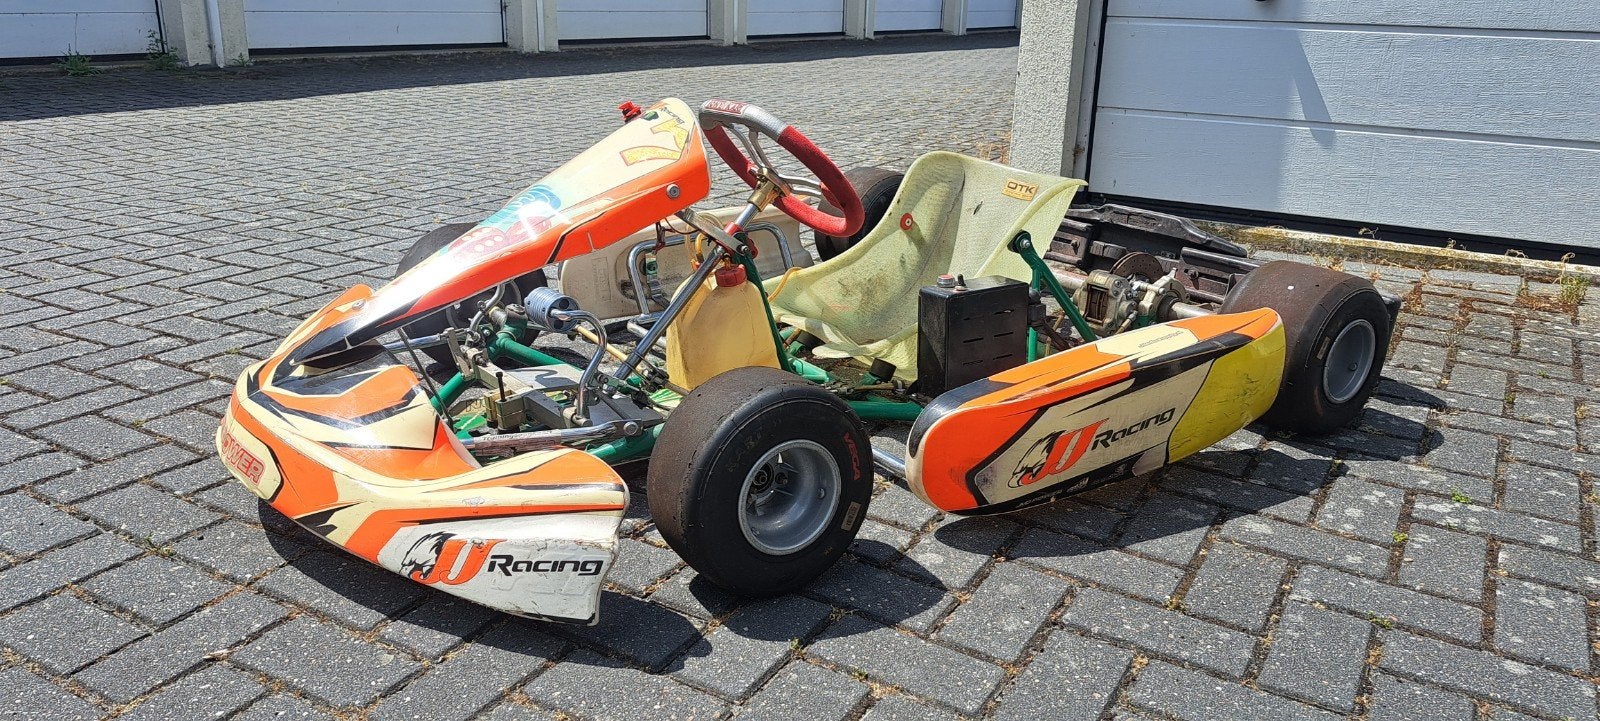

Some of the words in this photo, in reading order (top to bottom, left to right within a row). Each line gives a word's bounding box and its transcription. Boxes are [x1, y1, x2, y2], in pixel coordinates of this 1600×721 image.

[1007, 181, 1036, 194] OTK
[1091, 407, 1176, 451] Racing
[843, 431, 861, 481] VEGA
[487, 554, 604, 577] Racing
